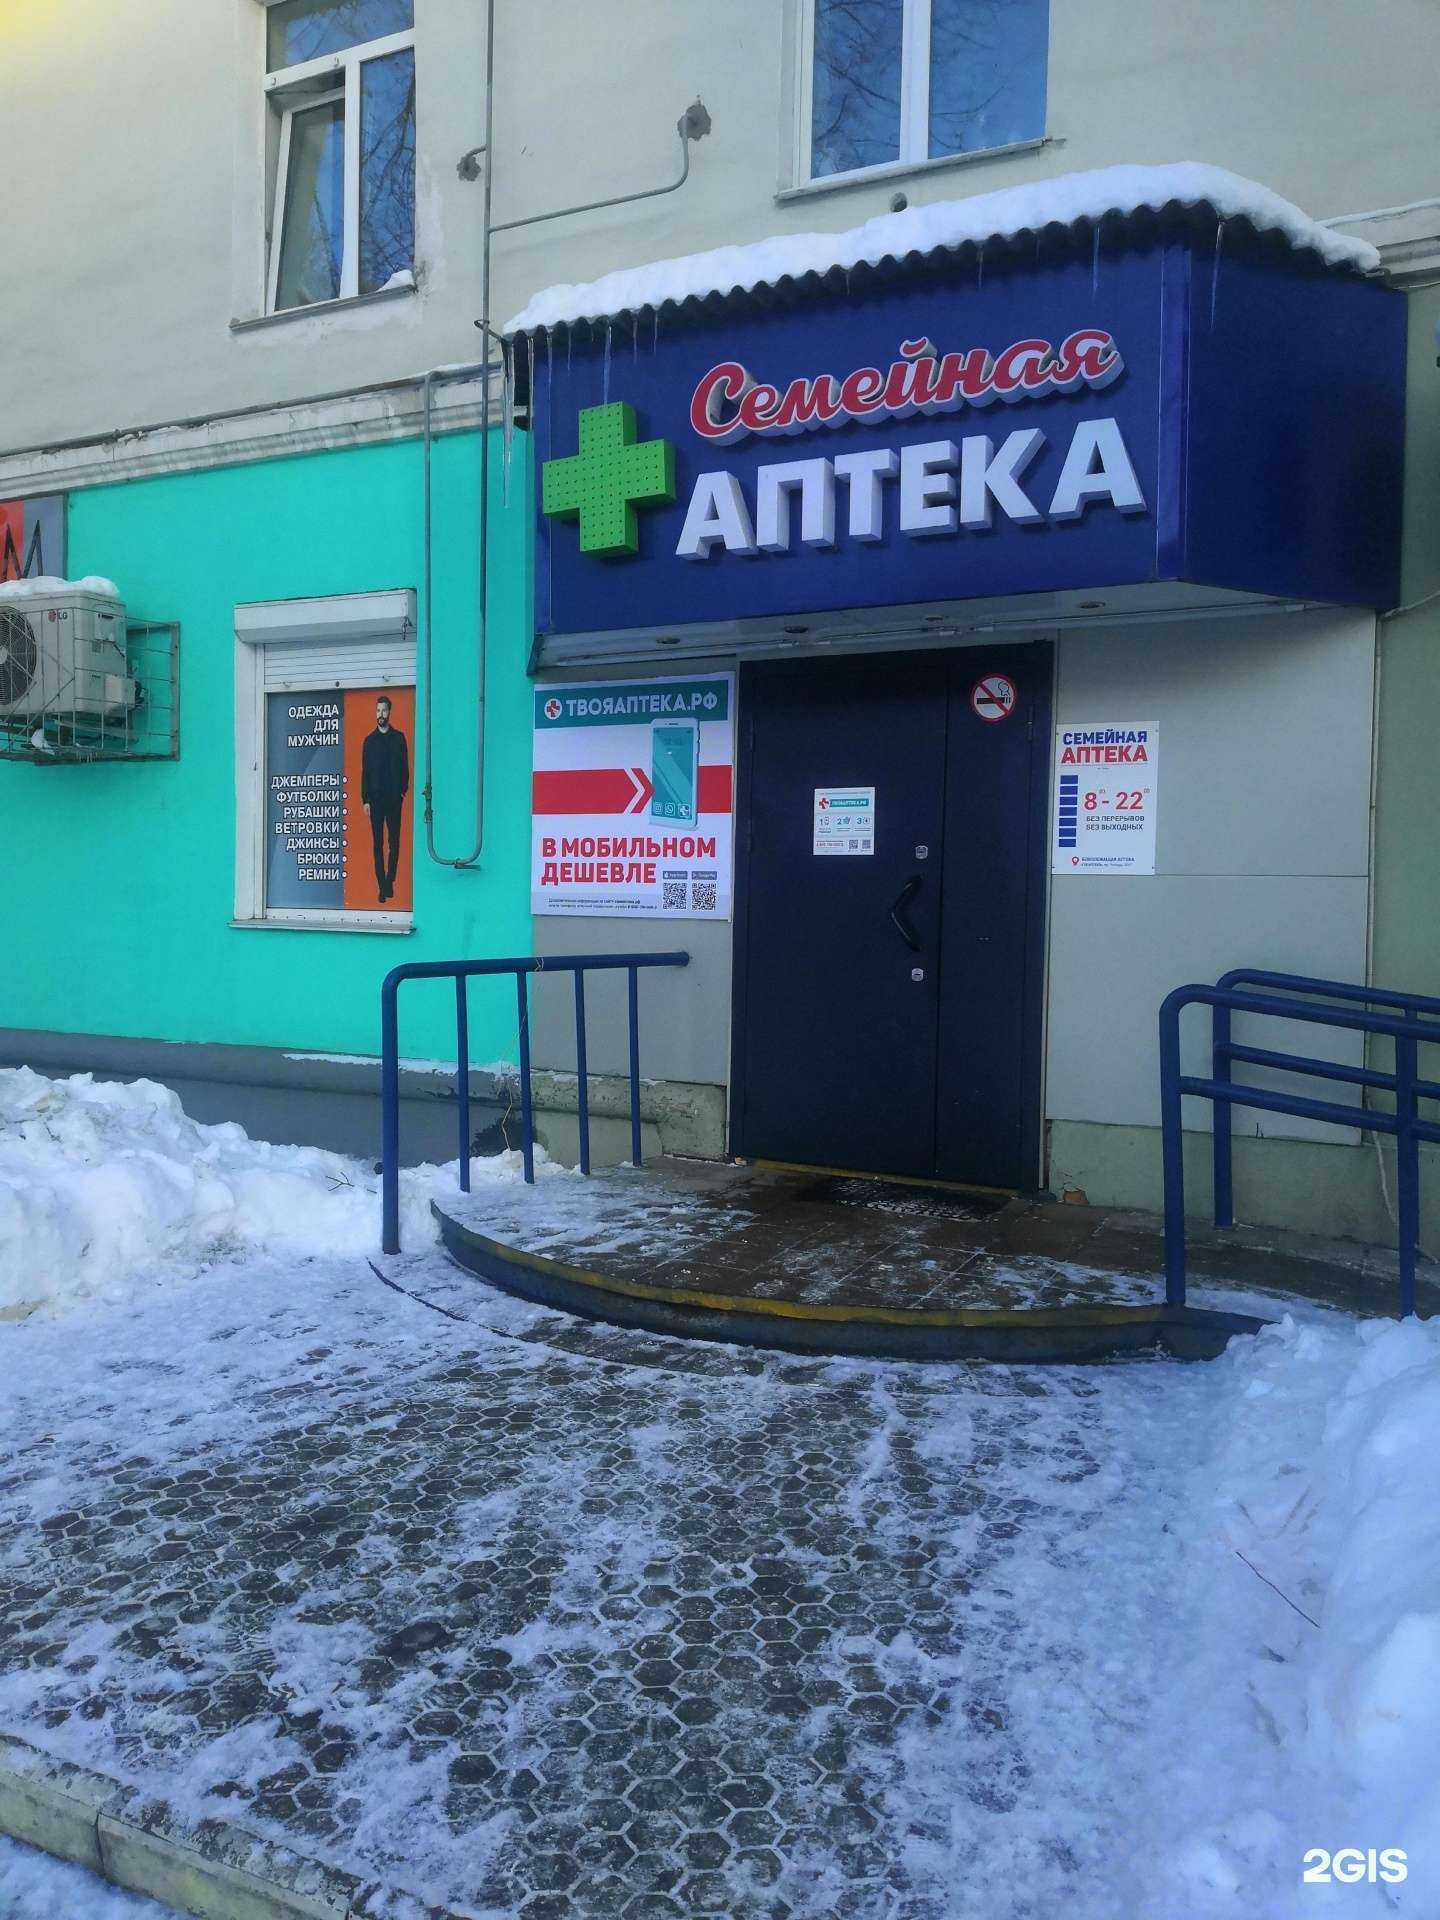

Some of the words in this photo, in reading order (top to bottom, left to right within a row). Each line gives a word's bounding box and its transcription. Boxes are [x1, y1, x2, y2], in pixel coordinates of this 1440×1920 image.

[690, 329, 1124, 444] Семейная
[675, 417, 1147, 560] АПТЕКА
[57, 611, 68, 620] LG
[288, 704, 339, 718] ОДЕЖДА
[566, 692, 718, 717] ТВОЯАПТЕКА.РФ
[314, 719, 339, 732] ДЛЯ
[288, 733, 339, 747] МУЖЧИН
[1063, 729, 1147, 745] СЕМЕЙНАЯ
[1061, 745, 1148, 764] АПТЕКА
[271, 774, 340, 789] ДЖЕМПЕРЫ
[276, 790, 340, 803] ФУТБОЛКИ
[284, 806, 340, 818] РУБАШКИ
[275, 822, 340, 835] ВЕТРОВКИ
[1101, 823, 1143, 831] ВЫХОДНЫХ
[286, 837, 340, 851] ДЖИНСЫ
[542, 837, 558, 858] В
[562, 837, 716, 858] МОБИЛЬНОМ
[297, 853, 340, 866] БРЮКИ
[298, 868, 340, 881] РЕМНИ
[541, 862, 657, 886] ДЕШЕВЛЕ
